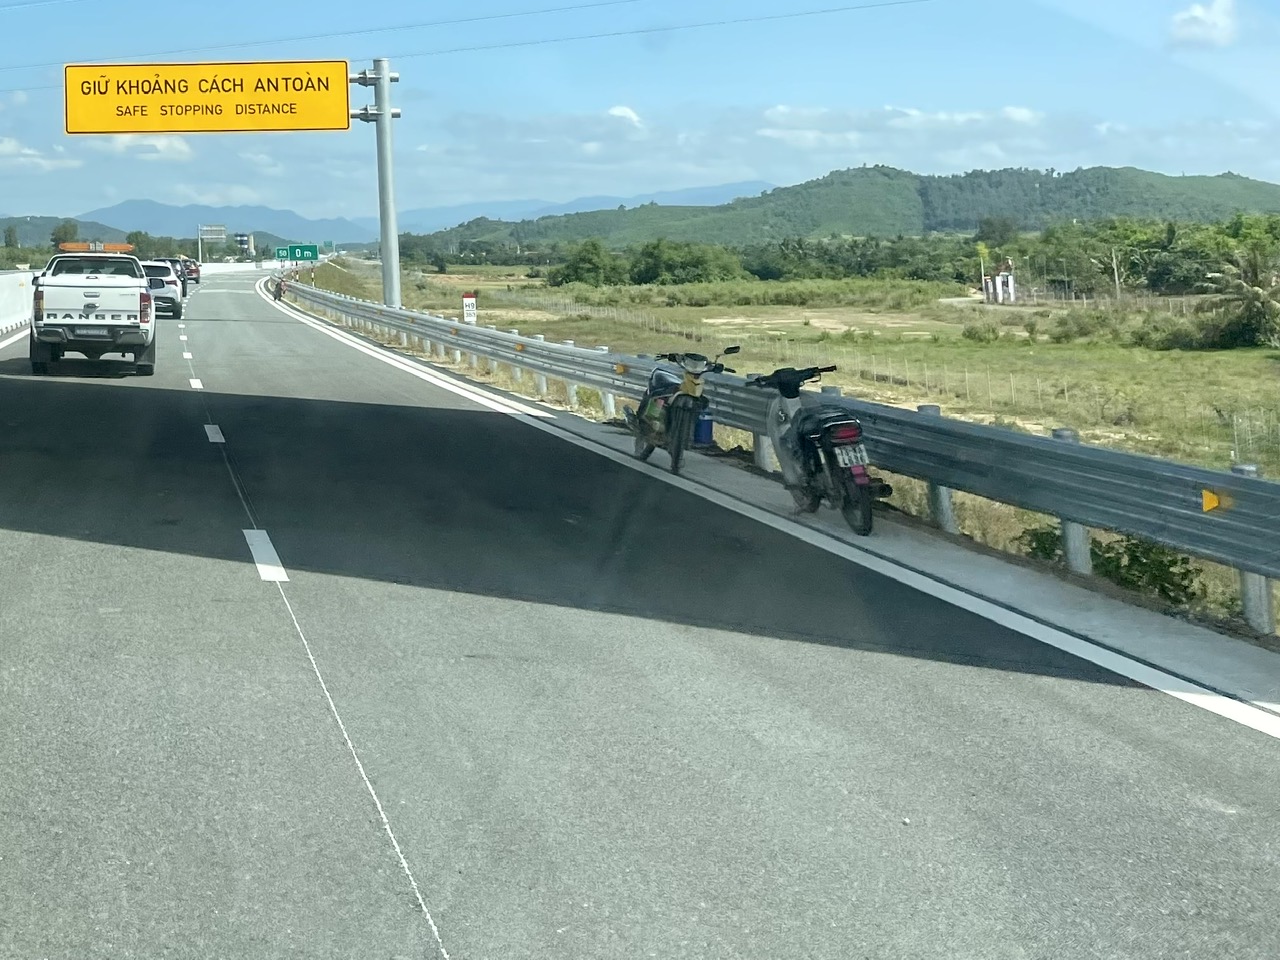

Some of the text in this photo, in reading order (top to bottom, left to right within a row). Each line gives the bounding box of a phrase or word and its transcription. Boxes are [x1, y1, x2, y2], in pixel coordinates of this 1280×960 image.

[81, 74, 111, 95] GIỮ
[116, 73, 189, 95] KHOẢNG
[198, 74, 244, 93] CÁCH
[116, 103, 298, 117] SAFE STOPPING DISTANCE
[46, 313, 138, 321] RANGER
